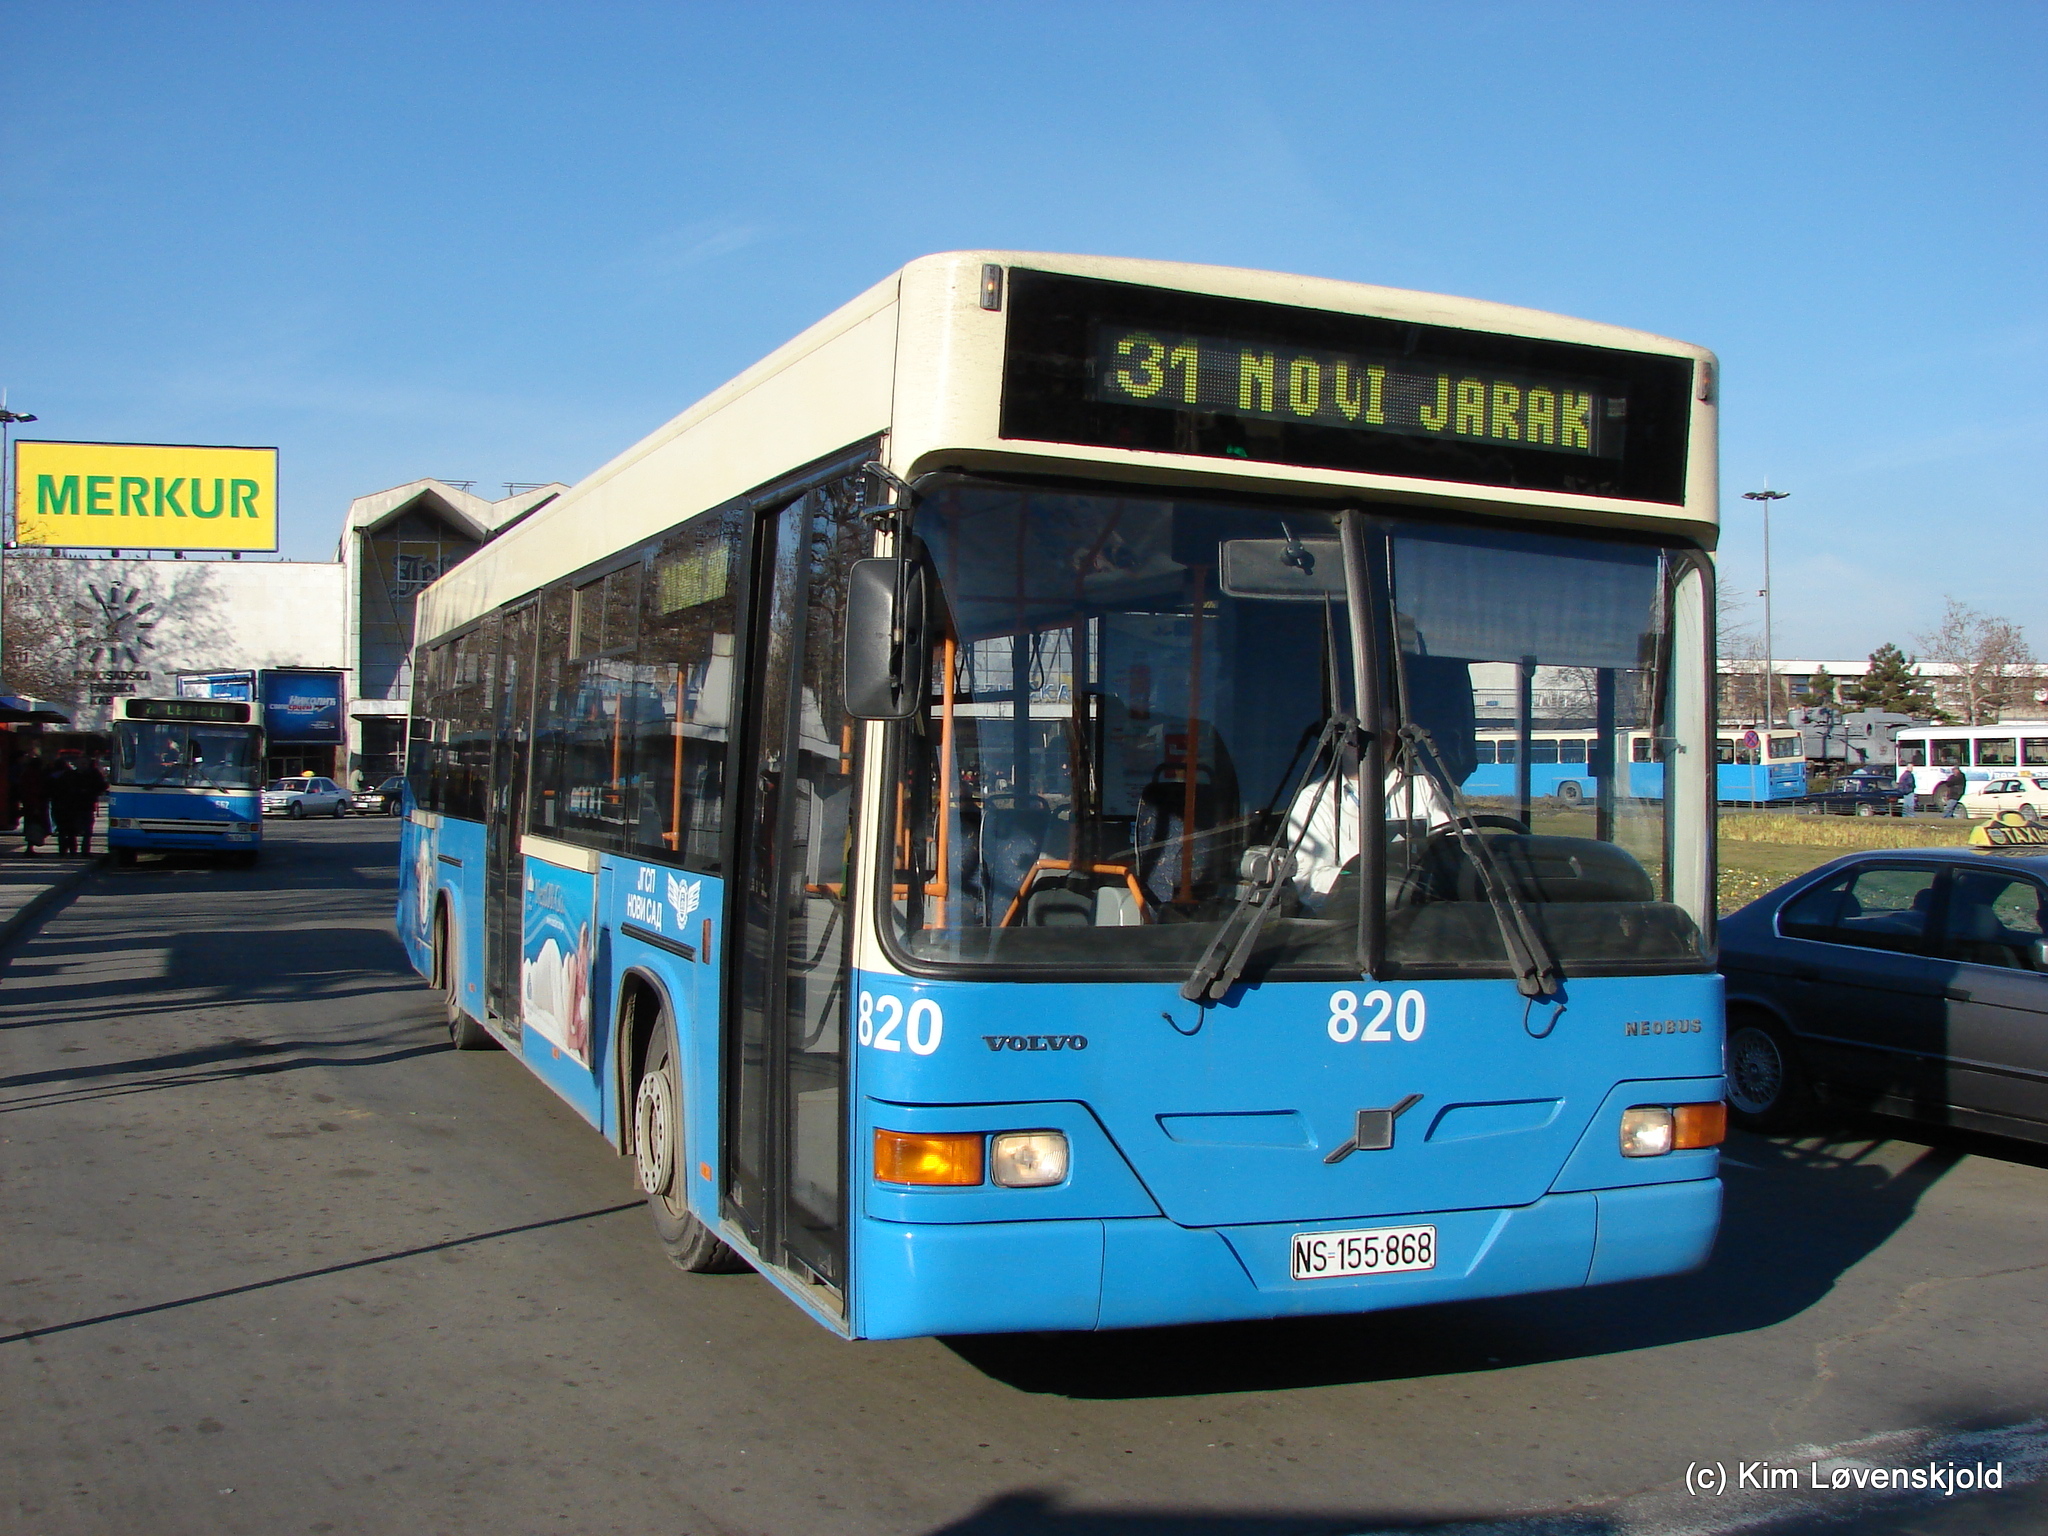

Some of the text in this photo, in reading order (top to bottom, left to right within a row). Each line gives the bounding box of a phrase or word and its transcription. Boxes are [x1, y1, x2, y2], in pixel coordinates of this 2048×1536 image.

[1116, 332, 1591, 449] 31 NOVI JARAK
[37, 474, 260, 519] MERKUR
[626, 893, 663, 932] НОВИ САД
[858, 990, 945, 1056] 820
[1326, 988, 1427, 1042] 820
[1624, 1018, 1702, 1037] NEOBUS
[981, 1034, 1088, 1052] VOLVO
